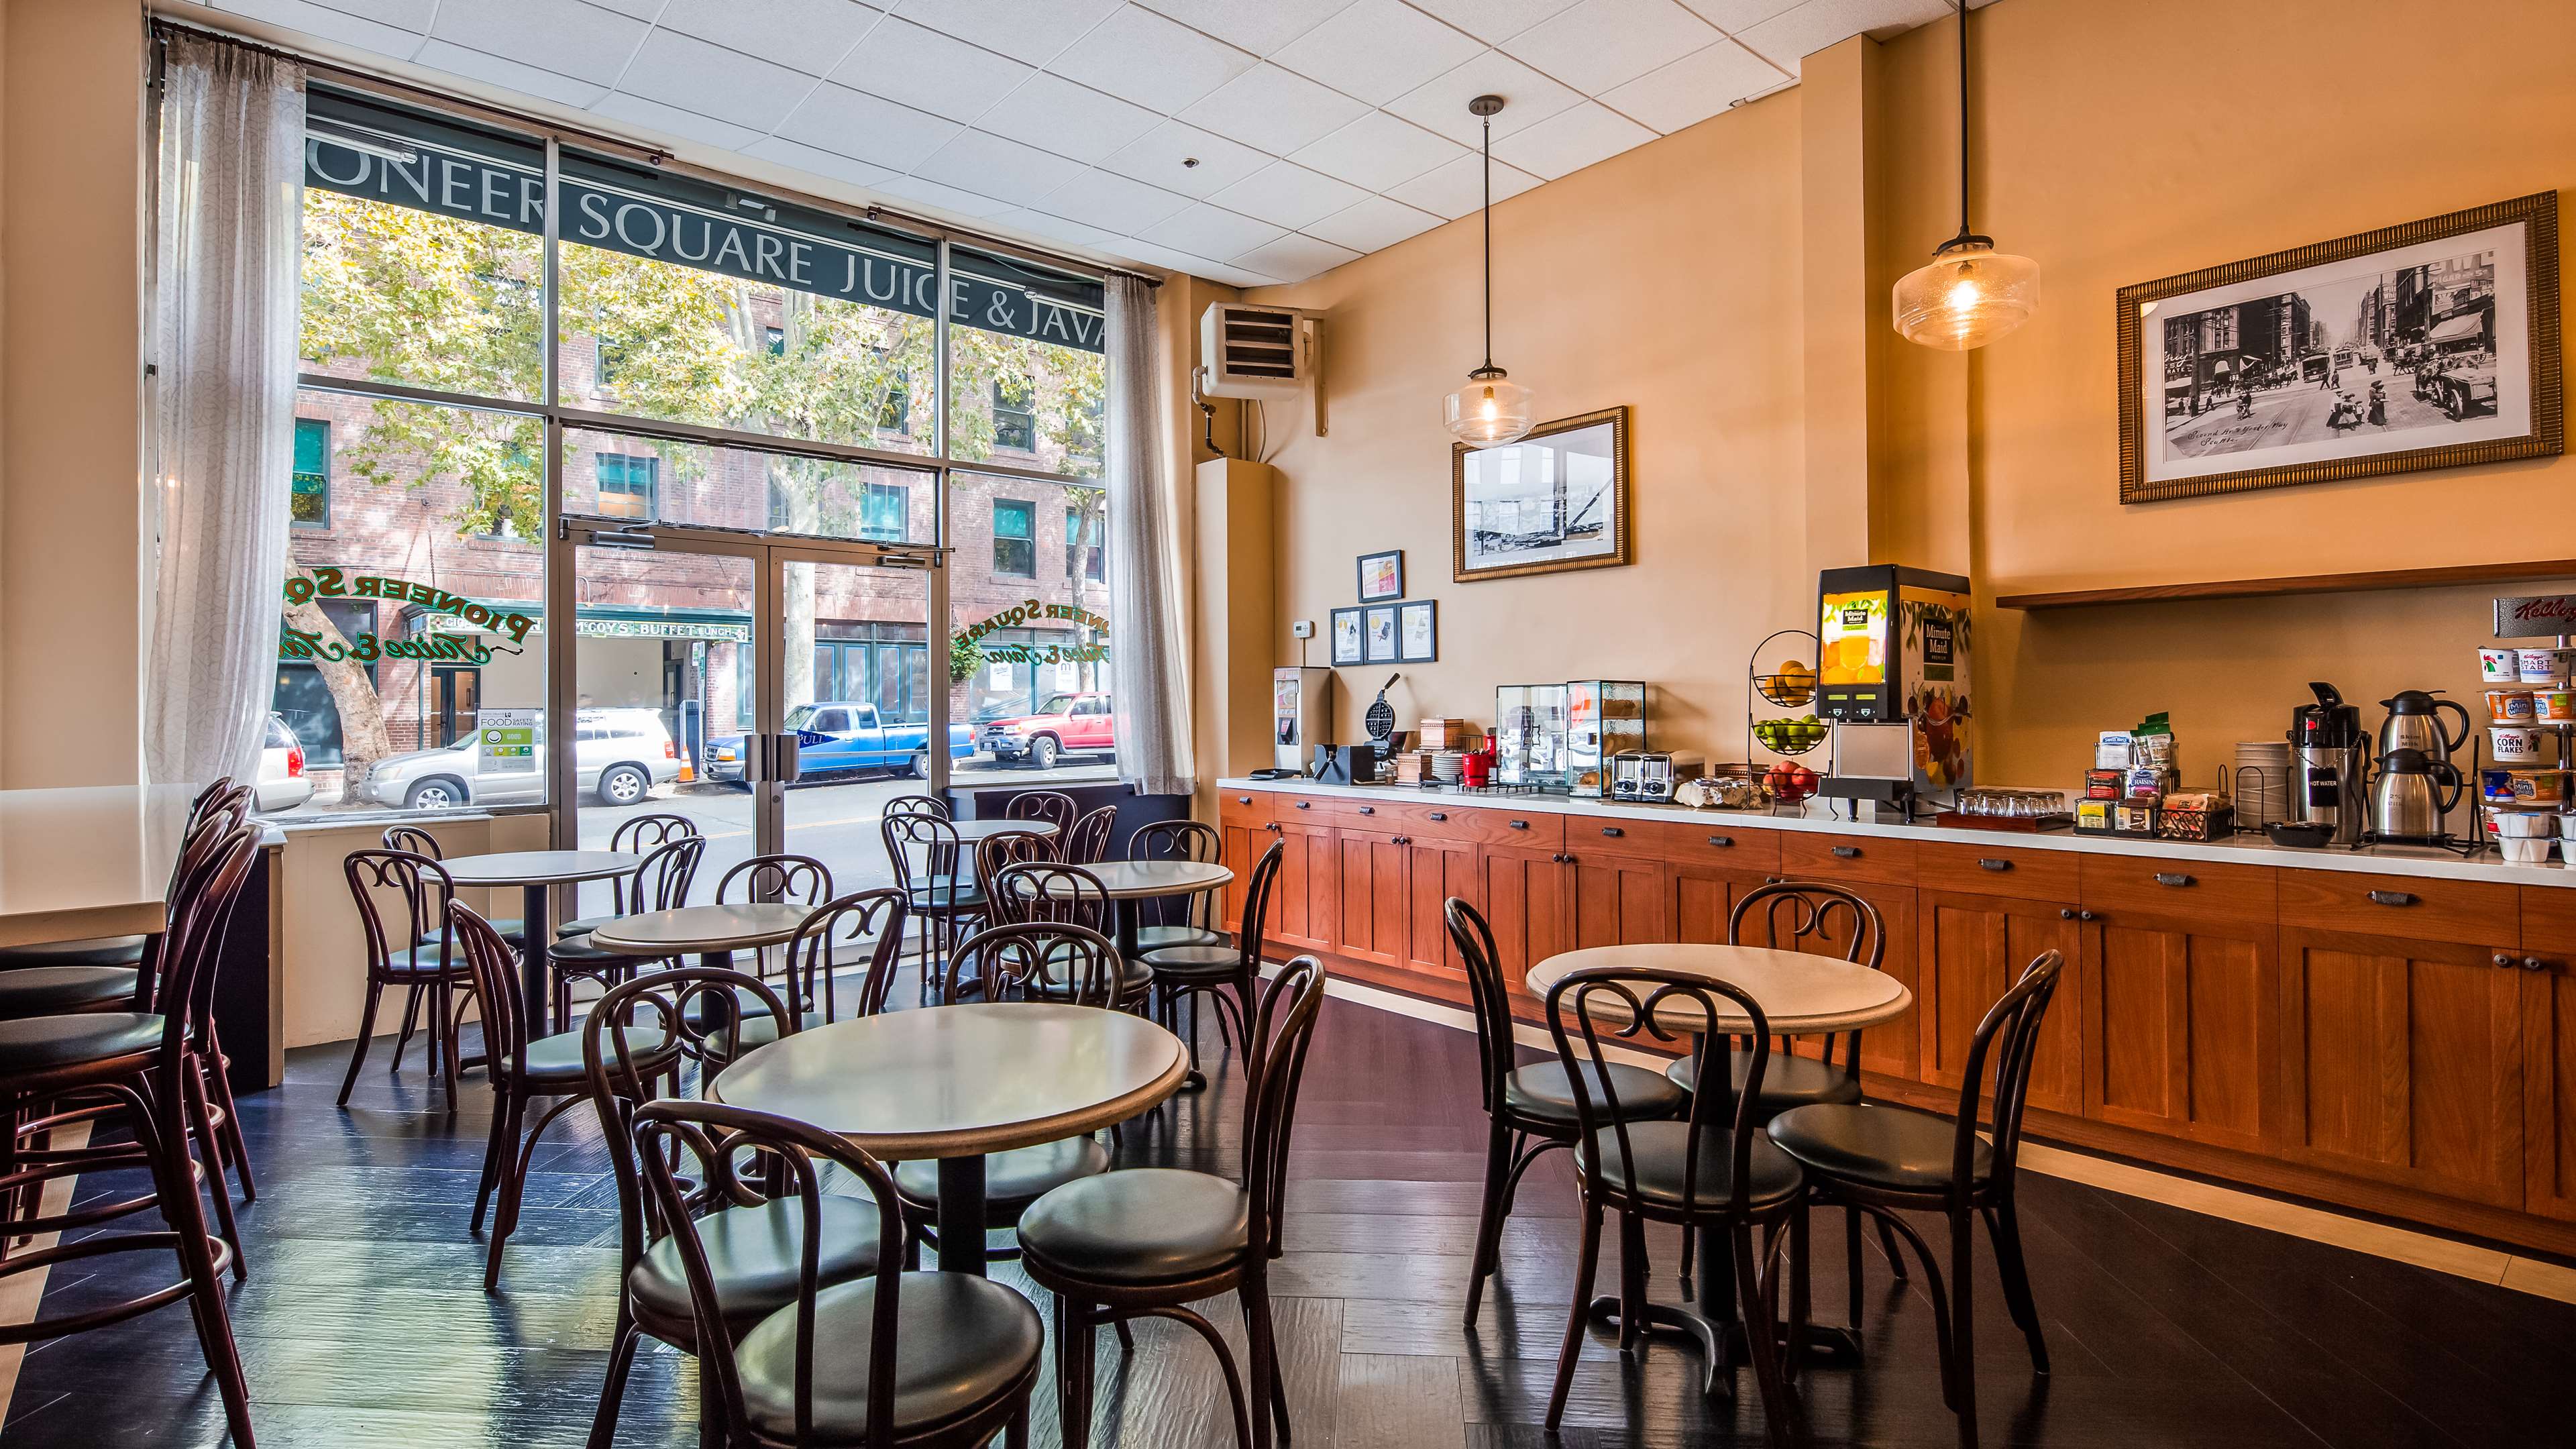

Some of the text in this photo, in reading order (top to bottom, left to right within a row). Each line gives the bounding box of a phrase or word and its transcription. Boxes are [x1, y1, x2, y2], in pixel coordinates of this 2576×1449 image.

[579, 193, 812, 285] SQUARE
[840, 254, 971, 319] JUICE
[986, 290, 1016, 329] &
[2188, 430, 2218, 439] Second
[640, 623, 696, 636] BUFFET
[1926, 624, 1951, 639] Minute
[1929, 639, 1947, 653] Maid
[481, 718, 512, 727] FOOD
[2497, 739, 2523, 747] CORN
